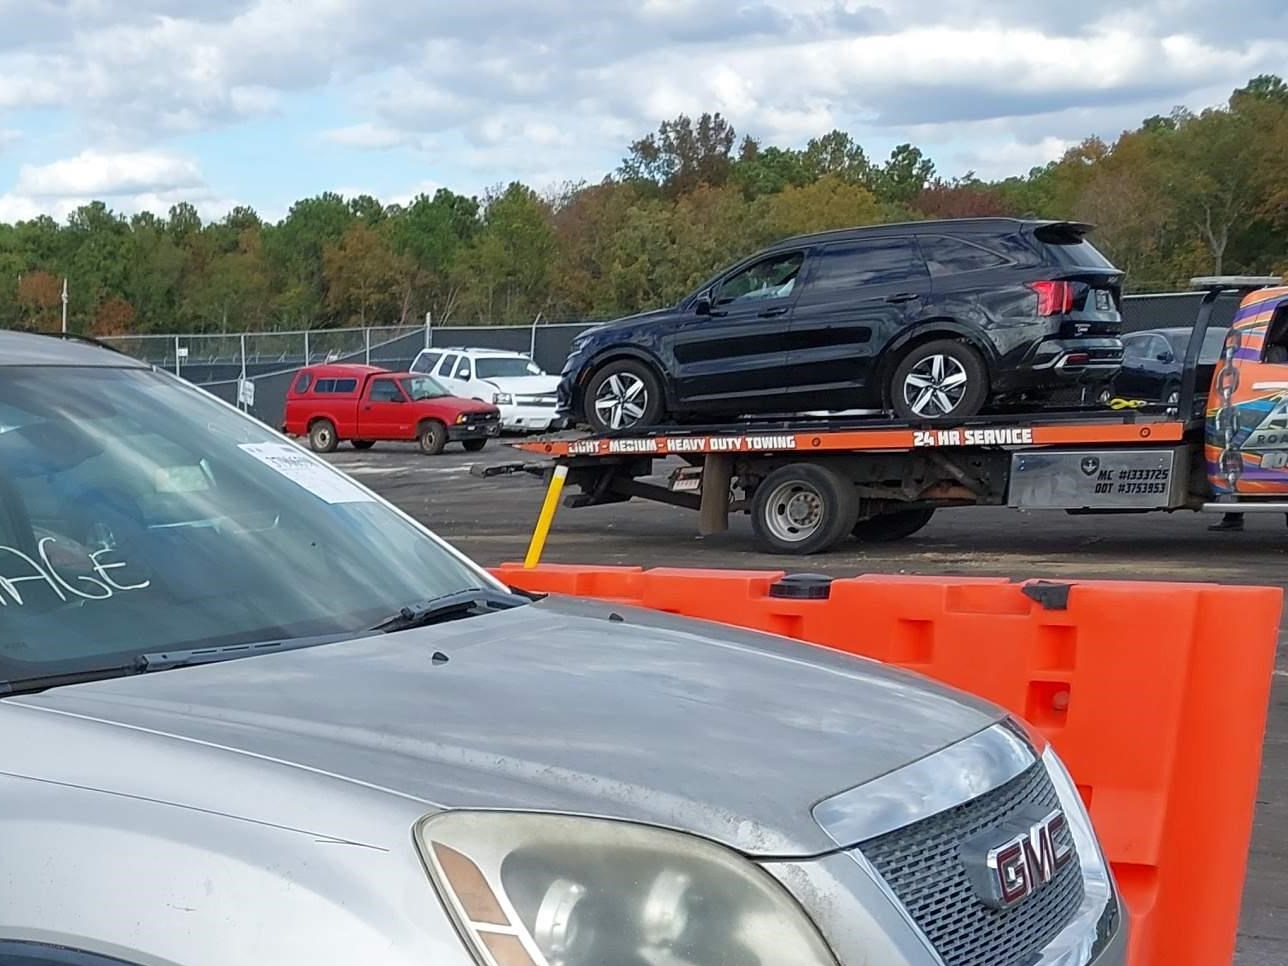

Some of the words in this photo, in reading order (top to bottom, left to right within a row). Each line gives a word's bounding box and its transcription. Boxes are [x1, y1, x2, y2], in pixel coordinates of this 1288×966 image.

[568, 441, 601, 453] LIGHT
[609, 439, 657, 452] MEDIUM
[667, 438, 705, 451] HEAVY
[710, 437, 742, 450] DUTY
[745, 435, 796, 449] TOWING
[913, 431, 935, 447] 24
[937, 430, 961, 446] HR
[964, 428, 1033, 445] SERVICE
[1097, 470, 1114, 480] MC
[1118, 469, 1170, 480] #1333725
[1094, 483, 1114, 493] DOT
[987, 808, 1073, 907] GMC
